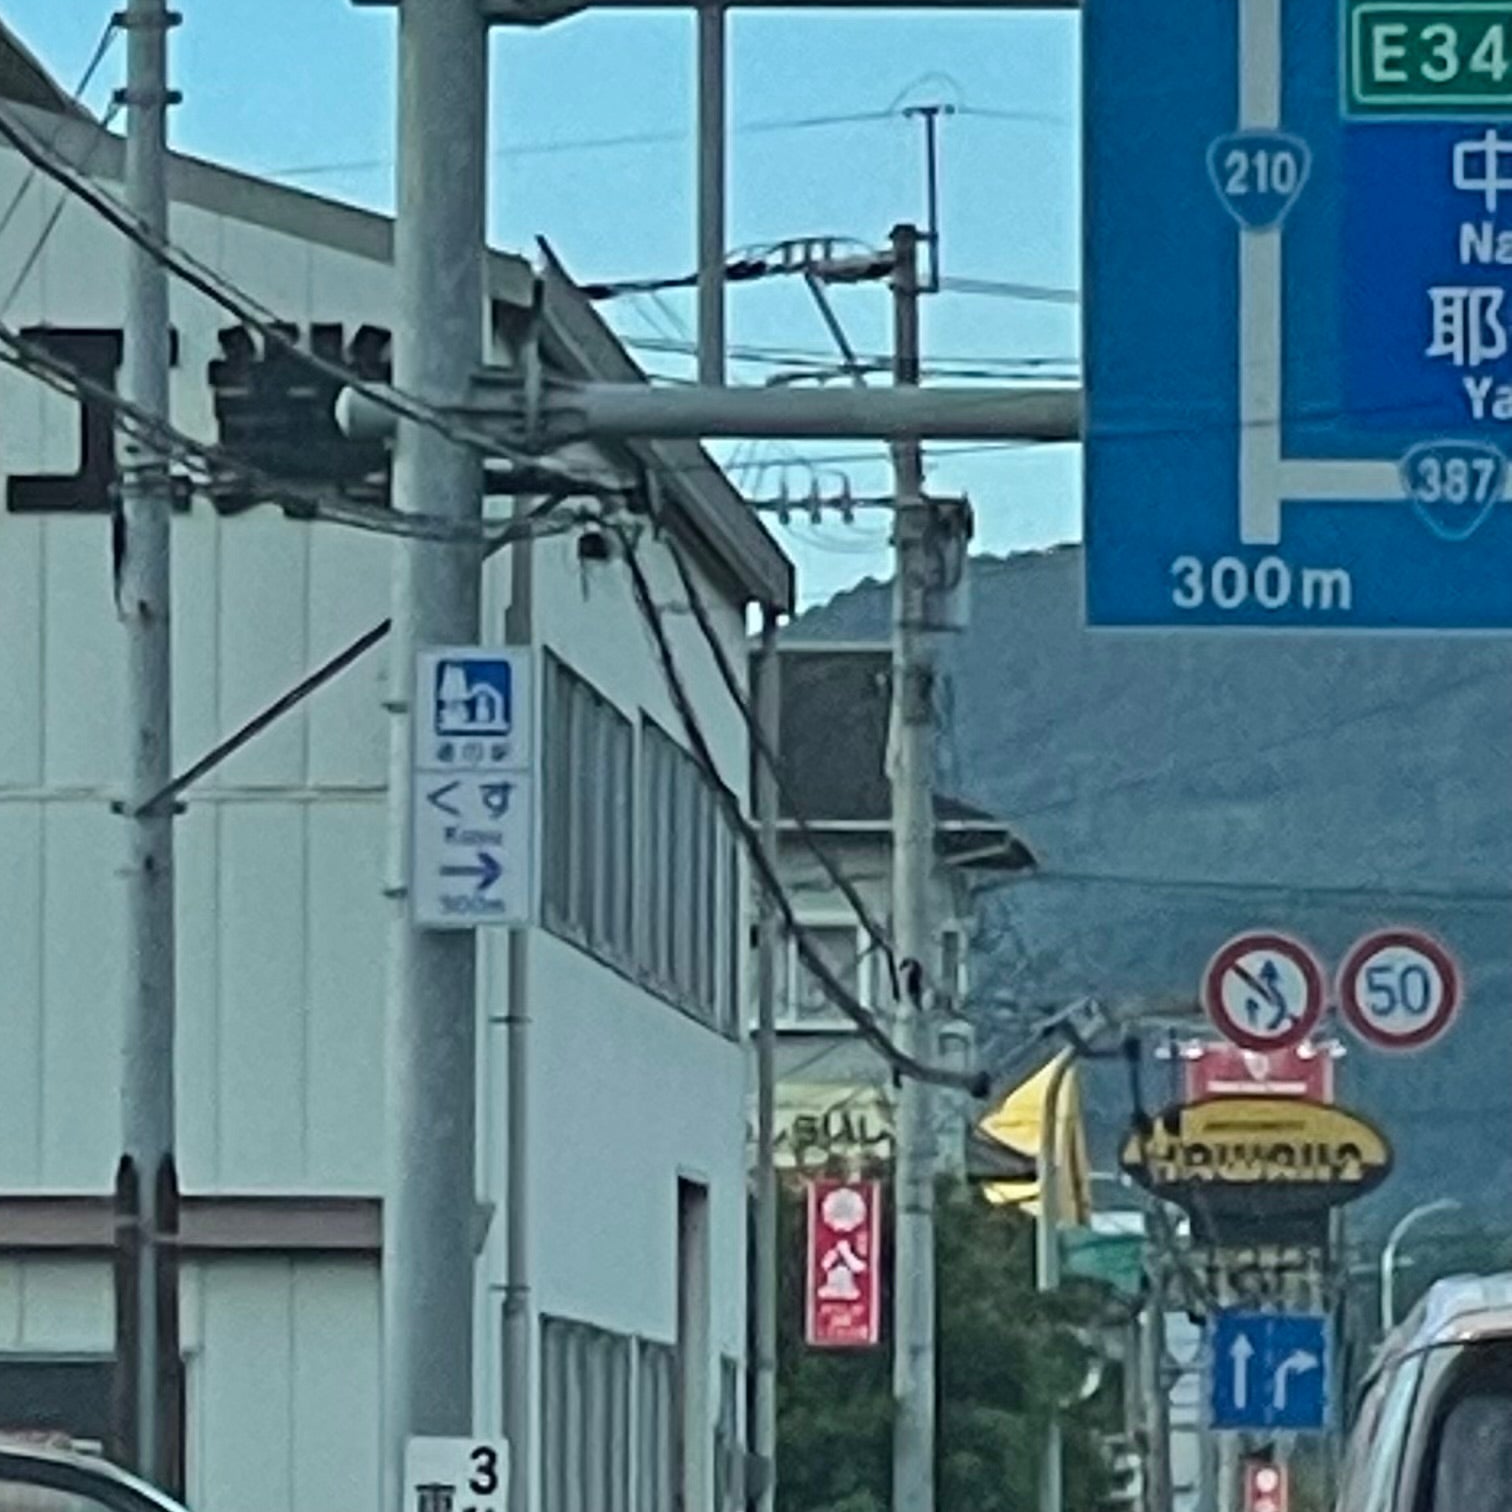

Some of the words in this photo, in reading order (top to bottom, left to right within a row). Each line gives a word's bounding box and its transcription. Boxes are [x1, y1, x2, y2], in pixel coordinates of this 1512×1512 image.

[1372, 23, 1510, 82] E34
[1225, 152, 1296, 194] 210
[1417, 458, 1496, 503] 387
[427, 781, 515, 819] くす
[1366, 966, 1431, 1014] 50
